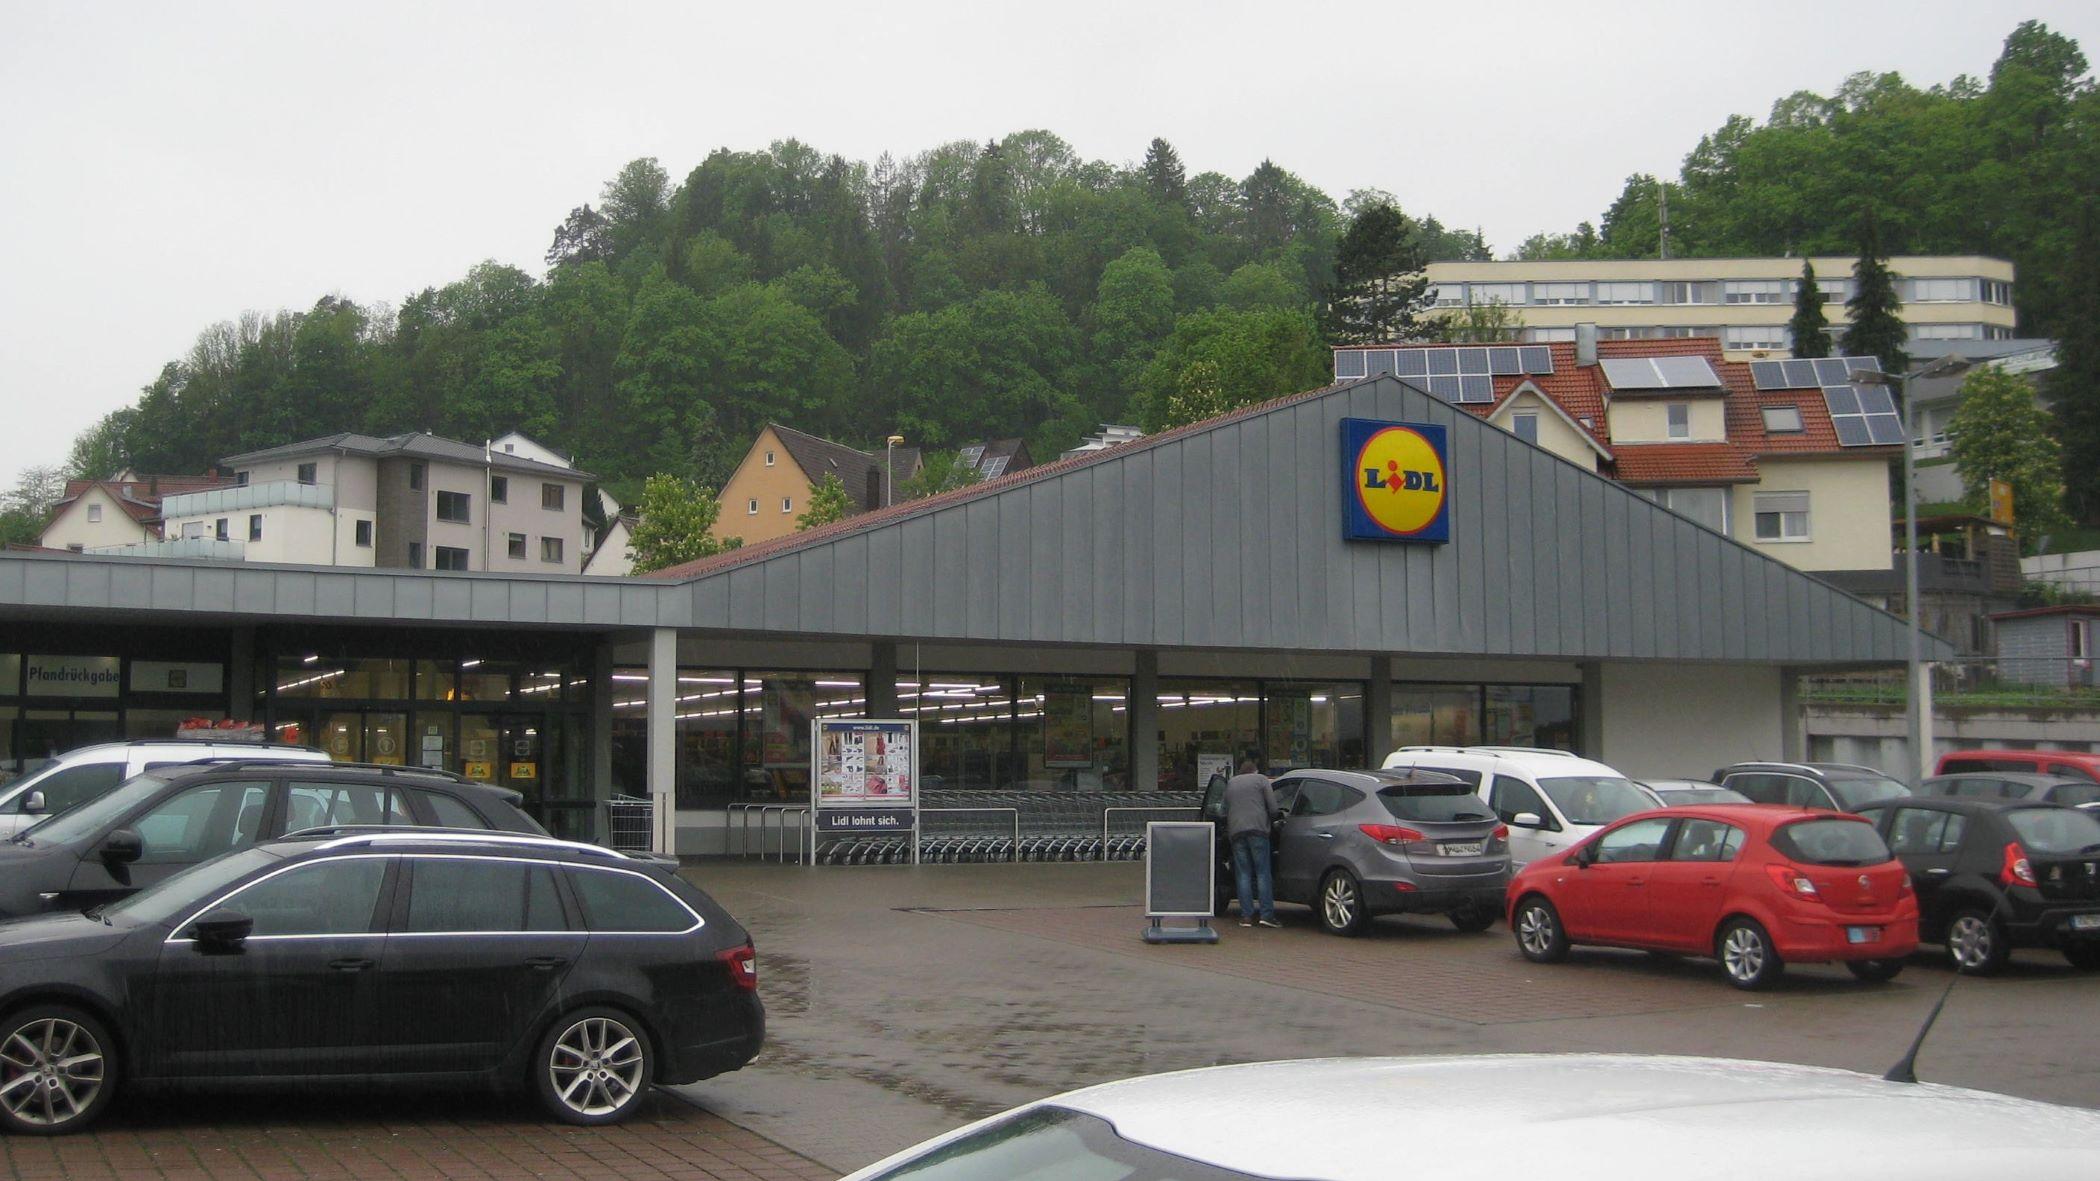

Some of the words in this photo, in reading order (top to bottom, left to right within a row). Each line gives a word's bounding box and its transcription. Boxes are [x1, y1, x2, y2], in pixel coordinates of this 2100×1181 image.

[29, 666, 120, 685] Pfandrückgabe
[831, 815, 849, 826] Lidl
[852, 815, 876, 826] lohnt
[877, 815, 900, 826] sich.
